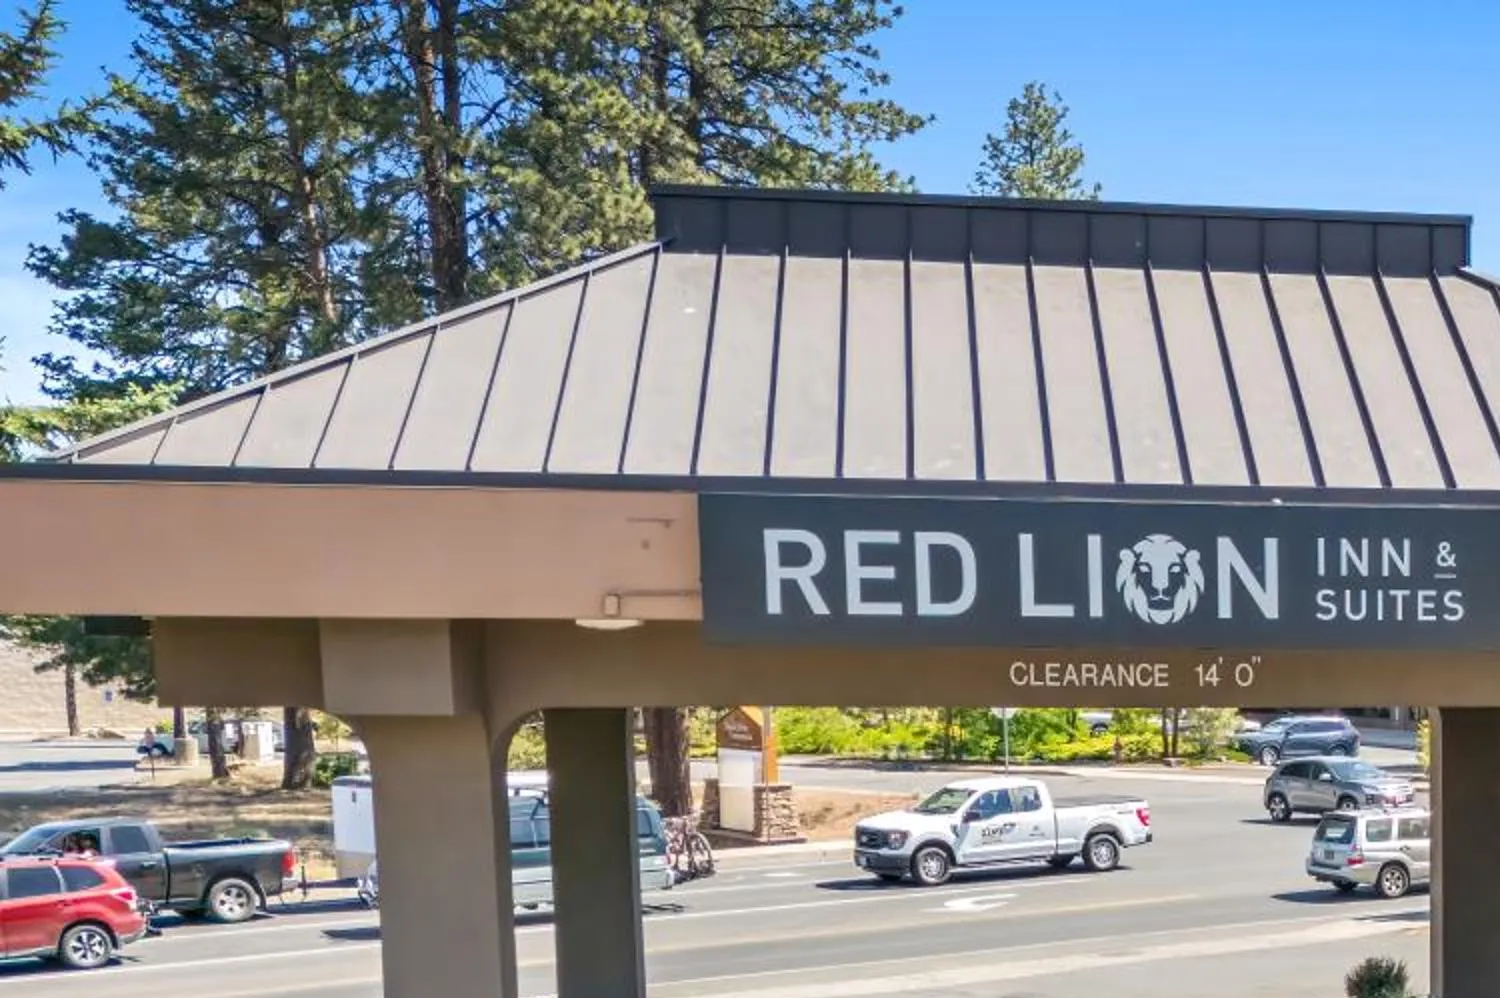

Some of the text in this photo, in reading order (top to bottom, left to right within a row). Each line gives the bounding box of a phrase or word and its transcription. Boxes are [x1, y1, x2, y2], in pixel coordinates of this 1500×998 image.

[763, 527, 977, 617] RED
[1317, 537, 1457, 577] INN &
[1315, 589, 1465, 621] SUITES
[1009, 661, 1169, 687] CLEARANCE
